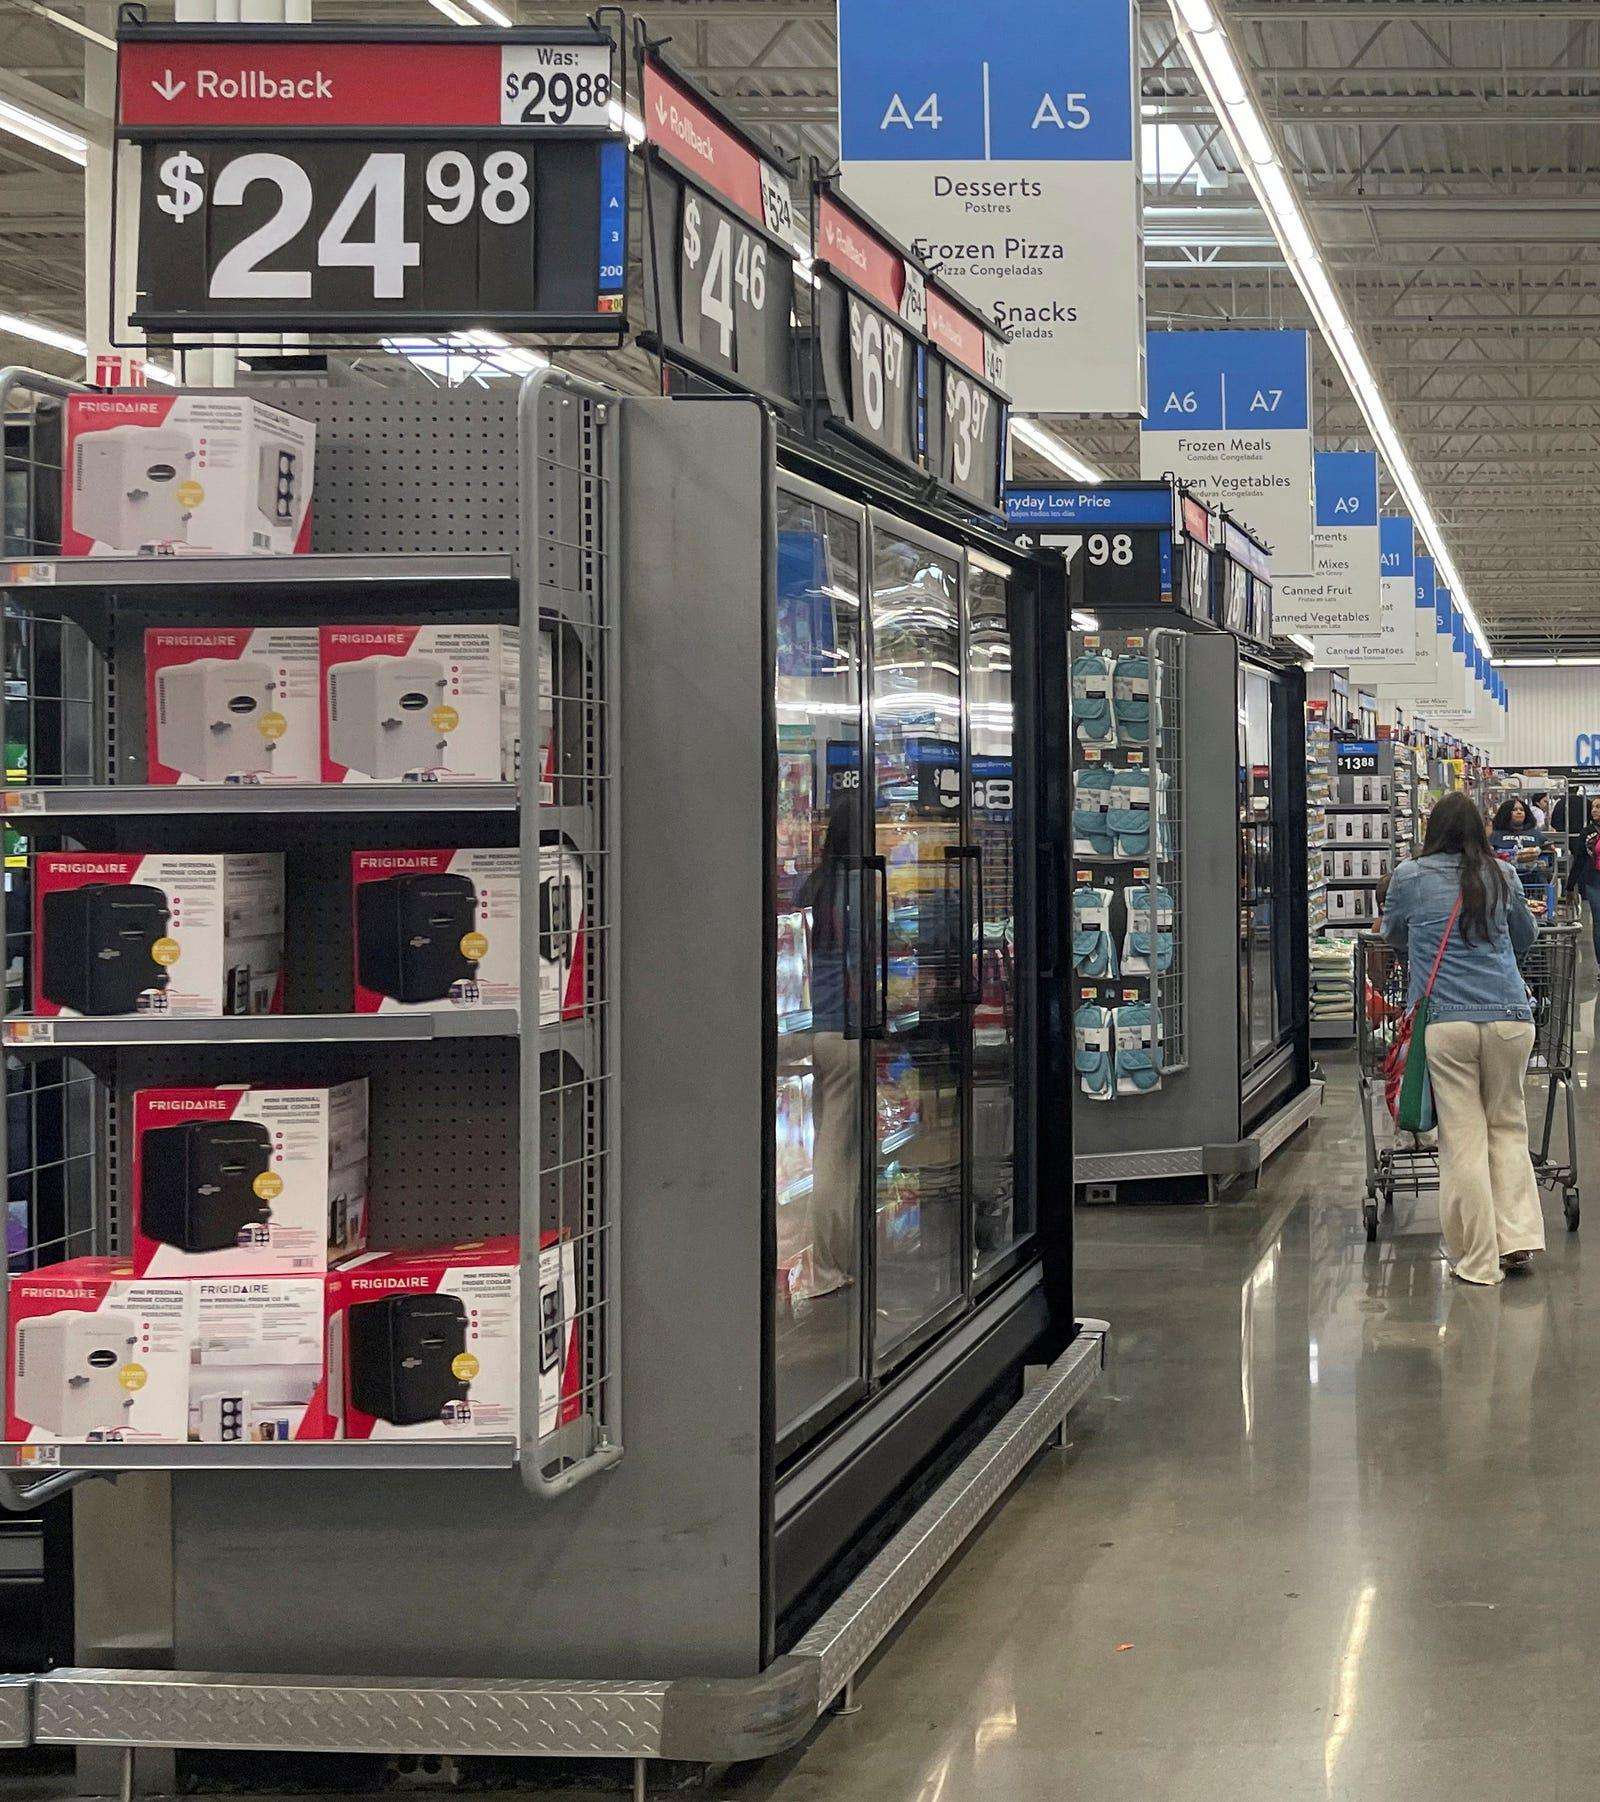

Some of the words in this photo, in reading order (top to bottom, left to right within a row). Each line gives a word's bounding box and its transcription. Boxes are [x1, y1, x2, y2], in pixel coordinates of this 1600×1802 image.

[537, 48, 579, 66] Was:
[197, 70, 332, 100] Rollback
[879, 93, 942, 130] A4
[1031, 93, 1090, 130] A5
[669, 106, 715, 163] Rollback
[933, 175, 1042, 198] Desserts
[609, 197, 619, 208] A
[965, 202, 1012, 213] Postres
[611, 231, 619, 242] 3
[914, 238, 995, 259] Frozen
[1005, 238, 1064, 259] Pizza
[600, 265, 624, 277] 200
[935, 264, 966, 276] Pizza
[970, 264, 1043, 278] Congeladas
[993, 301, 1077, 323] Snacks
[1007, 329, 1053, 341] geladas
[1163, 391, 1198, 413] A6
[1250, 389, 1283, 412] A7
[78, 401, 159, 414] FRIGIDAIRE
[1178, 438, 1225, 452] Frozen
[1230, 438, 1271, 451] Meals
[1211, 475, 1291, 489] Vegetables
[1006, 495, 1045, 511] ryday
[1049, 495, 1074, 507] Low
[1079, 495, 1111, 507] Price
[1334, 497, 1359, 513] A9
[1318, 560, 1349, 569] Mixes
[1380, 553, 1400, 566] A11
[1282, 586, 1323, 596] Canned
[1326, 585, 1352, 595] Fruit
[1311, 612, 1369, 625] Vegetables
[157, 635, 236, 646] FRIGIDAIRE
[331, 633, 405, 644] FRIGIDAIRE
[1326, 647, 1359, 655] Canned
[1362, 646, 1404, 655] Tomatoes
[360, 856, 438, 868] FRIGIDAIRE
[50, 863, 128, 875] FRIGIDAIRE
[149, 1100, 227, 1110] FRIGIDAIRE
[199, 1284, 269, 1295] FRIGIDAIRE
[351, 1276, 430, 1290] FRIGIDAIRE
[21, 1287, 97, 1299] FRIGIDAIRE
